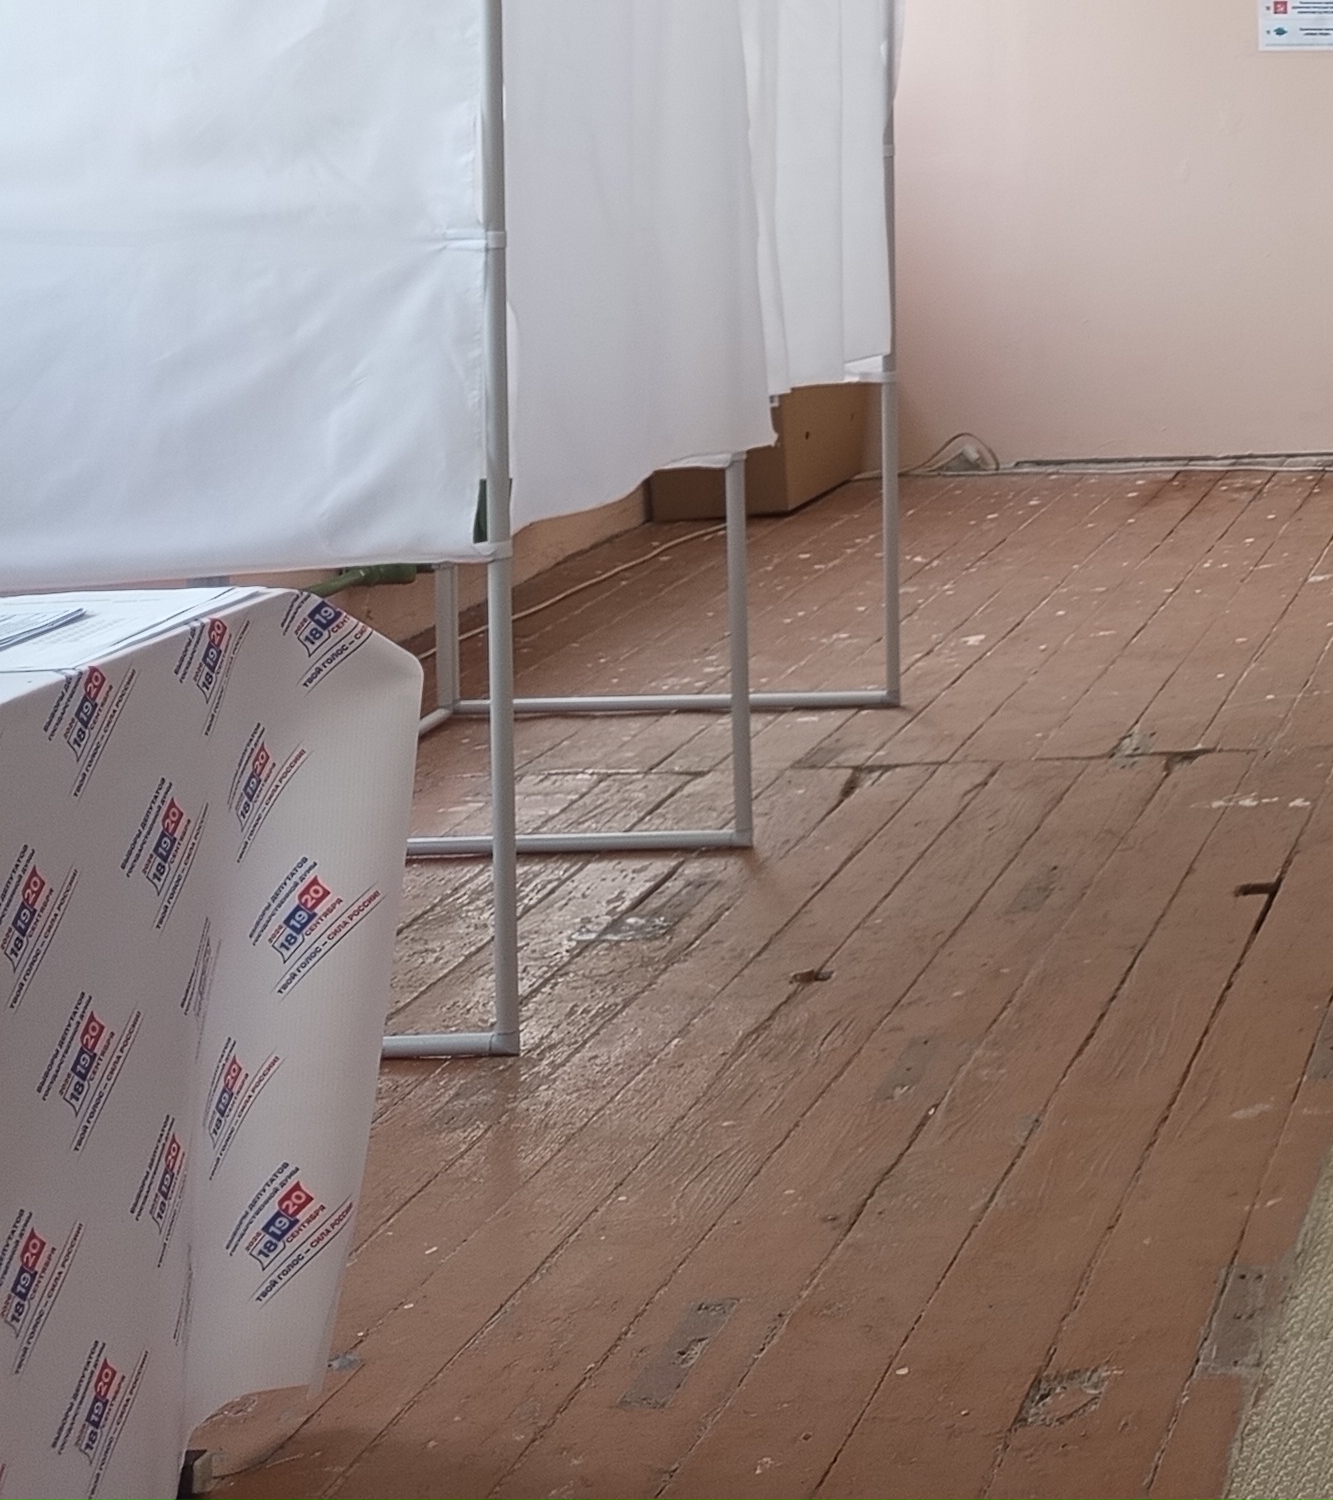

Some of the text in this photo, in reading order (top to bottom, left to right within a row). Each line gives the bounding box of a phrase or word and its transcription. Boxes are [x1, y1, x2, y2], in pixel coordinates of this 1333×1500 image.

[304, 606, 335, 645] 18 19
[331, 614, 349, 633] СЕНТ
[302, 644, 349, 688] ТВОЙ ГОЛОС
[249, 856, 308, 939] ВЫБОРЫ ДЕПУТАТОВ
[299, 861, 318, 883] ДУМЫ
[277, 890, 381, 994] ТВОЙ ГОЛОС СИЛА РОССИИ!
[280, 885, 324, 952] 18 19 20
[305, 897, 343, 937] СЕНТЯБРЯ
[36, 991, 85, 1094] ВЫБОРЫ ДЕПУТАТОВ
[70, 1023, 99, 1101] 18 19 20
[89, 1031, 115, 1082] СЕНТЯБРЯ
[74, 1011, 141, 1152] ТВОЙ ГОЛОС СИЛА РОССИИ!
[248, 1161, 289, 1211] ДЕПУТАТОВ
[279, 1166, 300, 1189] ДУМЫ
[258, 1190, 306, 1258] 18 19 20
[286, 1204, 326, 1243] СЕНТЯБРЯ
[255, 1279, 279, 1302] ТВОЙ
[277, 1253, 305, 1281] ГОЛОС
[310, 1229, 331, 1248] СИЛА
